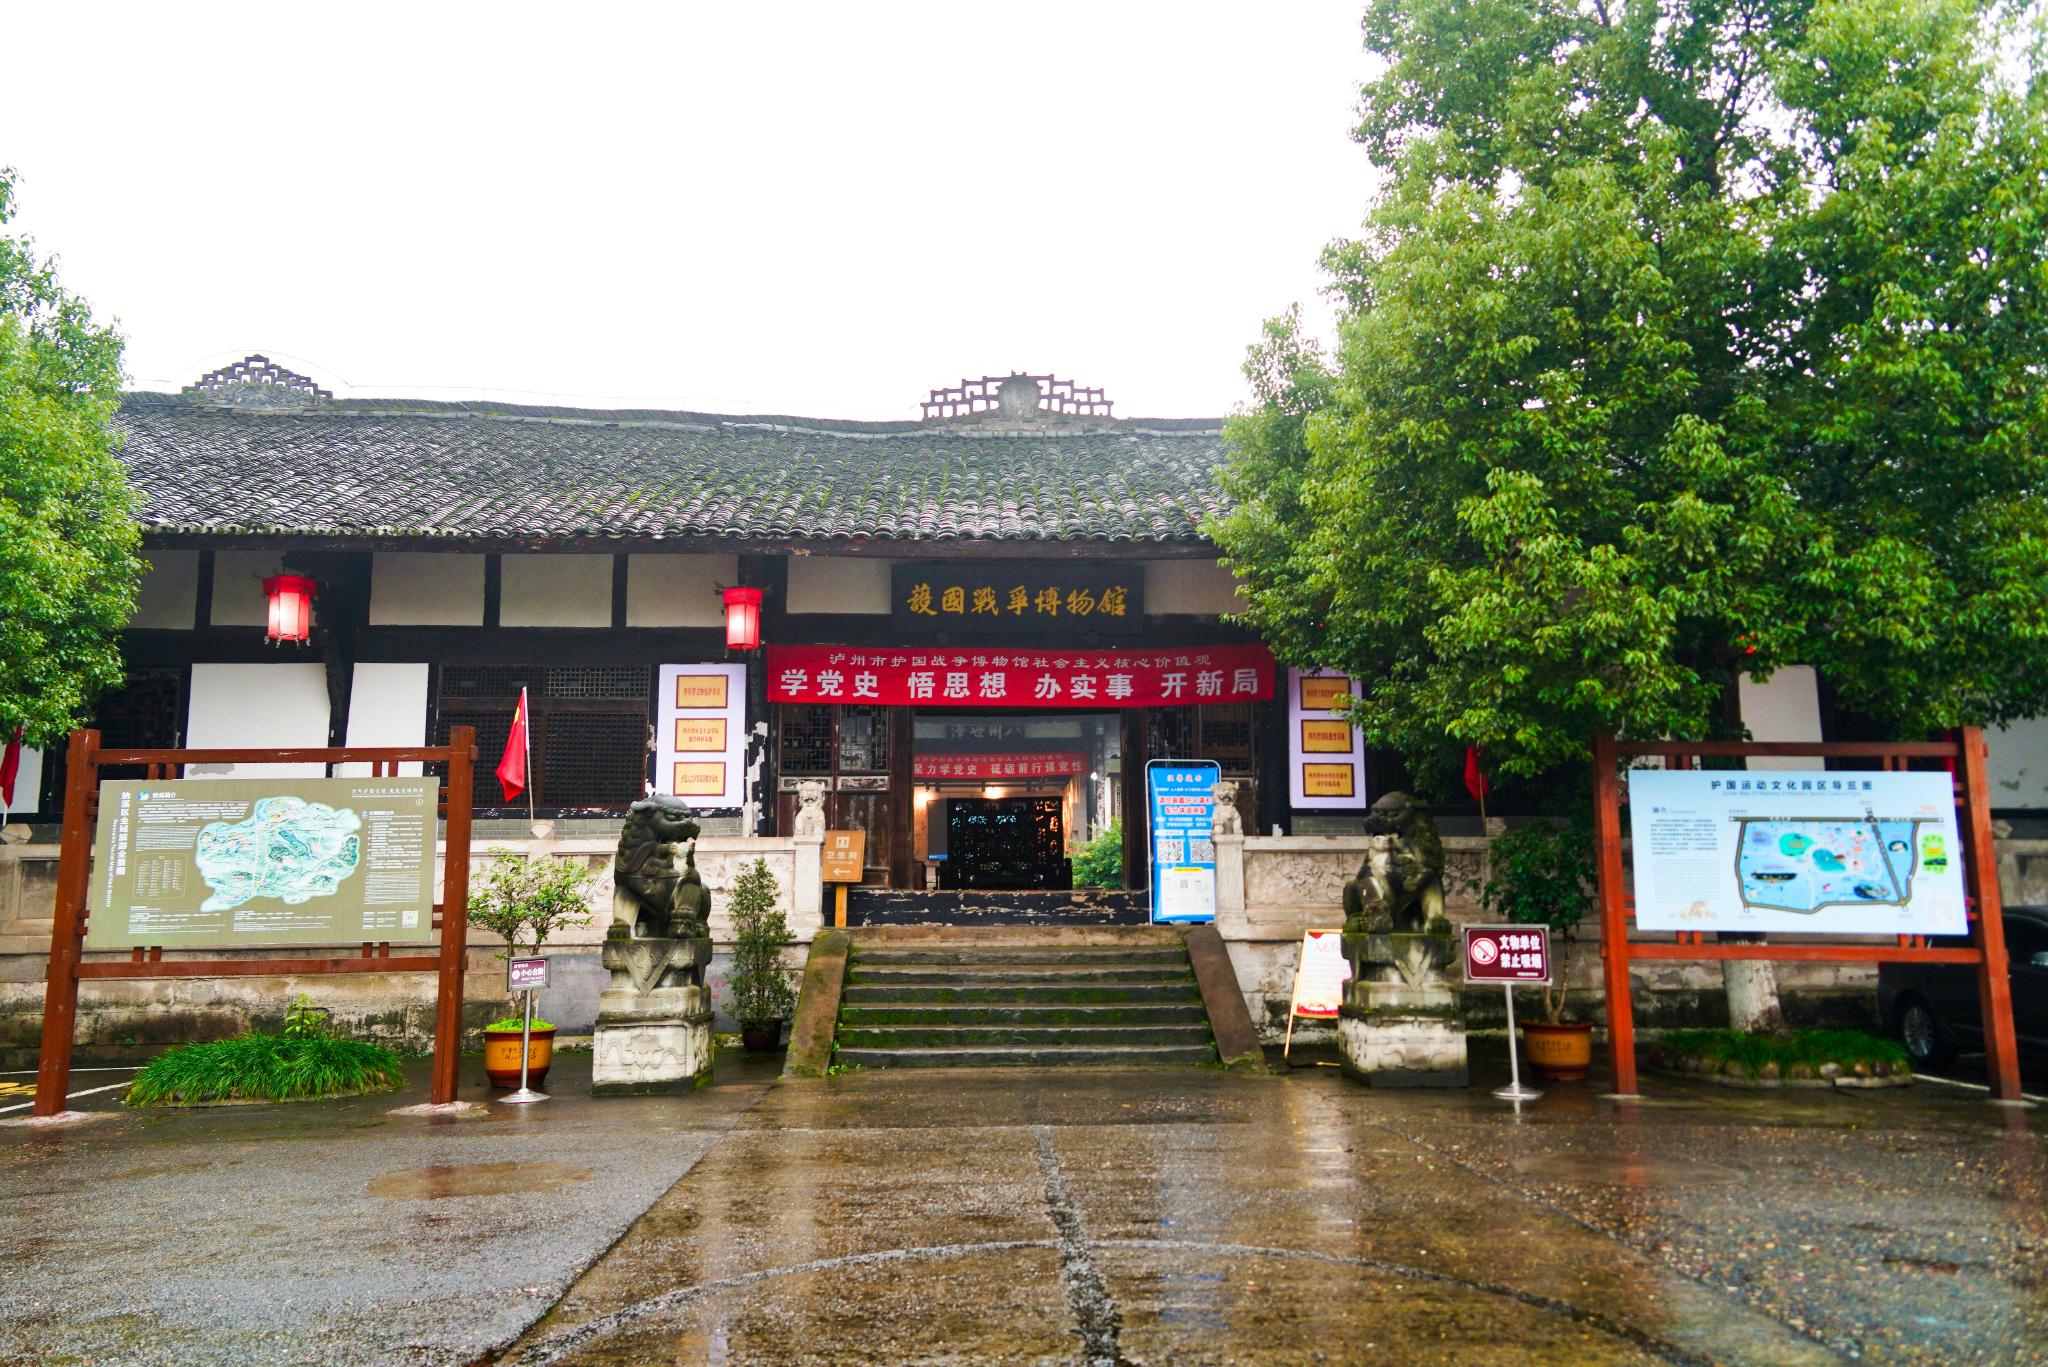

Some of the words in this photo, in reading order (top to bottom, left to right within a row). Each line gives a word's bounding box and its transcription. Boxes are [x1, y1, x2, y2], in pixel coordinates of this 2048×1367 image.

[905, 582, 1129, 617] 護國戰爭博物館
[828, 652, 1212, 668] 泸州市护国战争博物馆社会主义核心价值观
[780, 668, 880, 698] 学党史
[906, 671, 1007, 699] 悟思想
[1033, 672, 1134, 700] 办实事
[1160, 667, 1259, 698] 开新局
[1711, 780, 1873, 790] 护国运动文化园区导览图
[825, 851, 858, 861] 卫生间
[1498, 934, 1541, 951] 文物单位
[1499, 952, 1543, 969] 禁止吸烟
